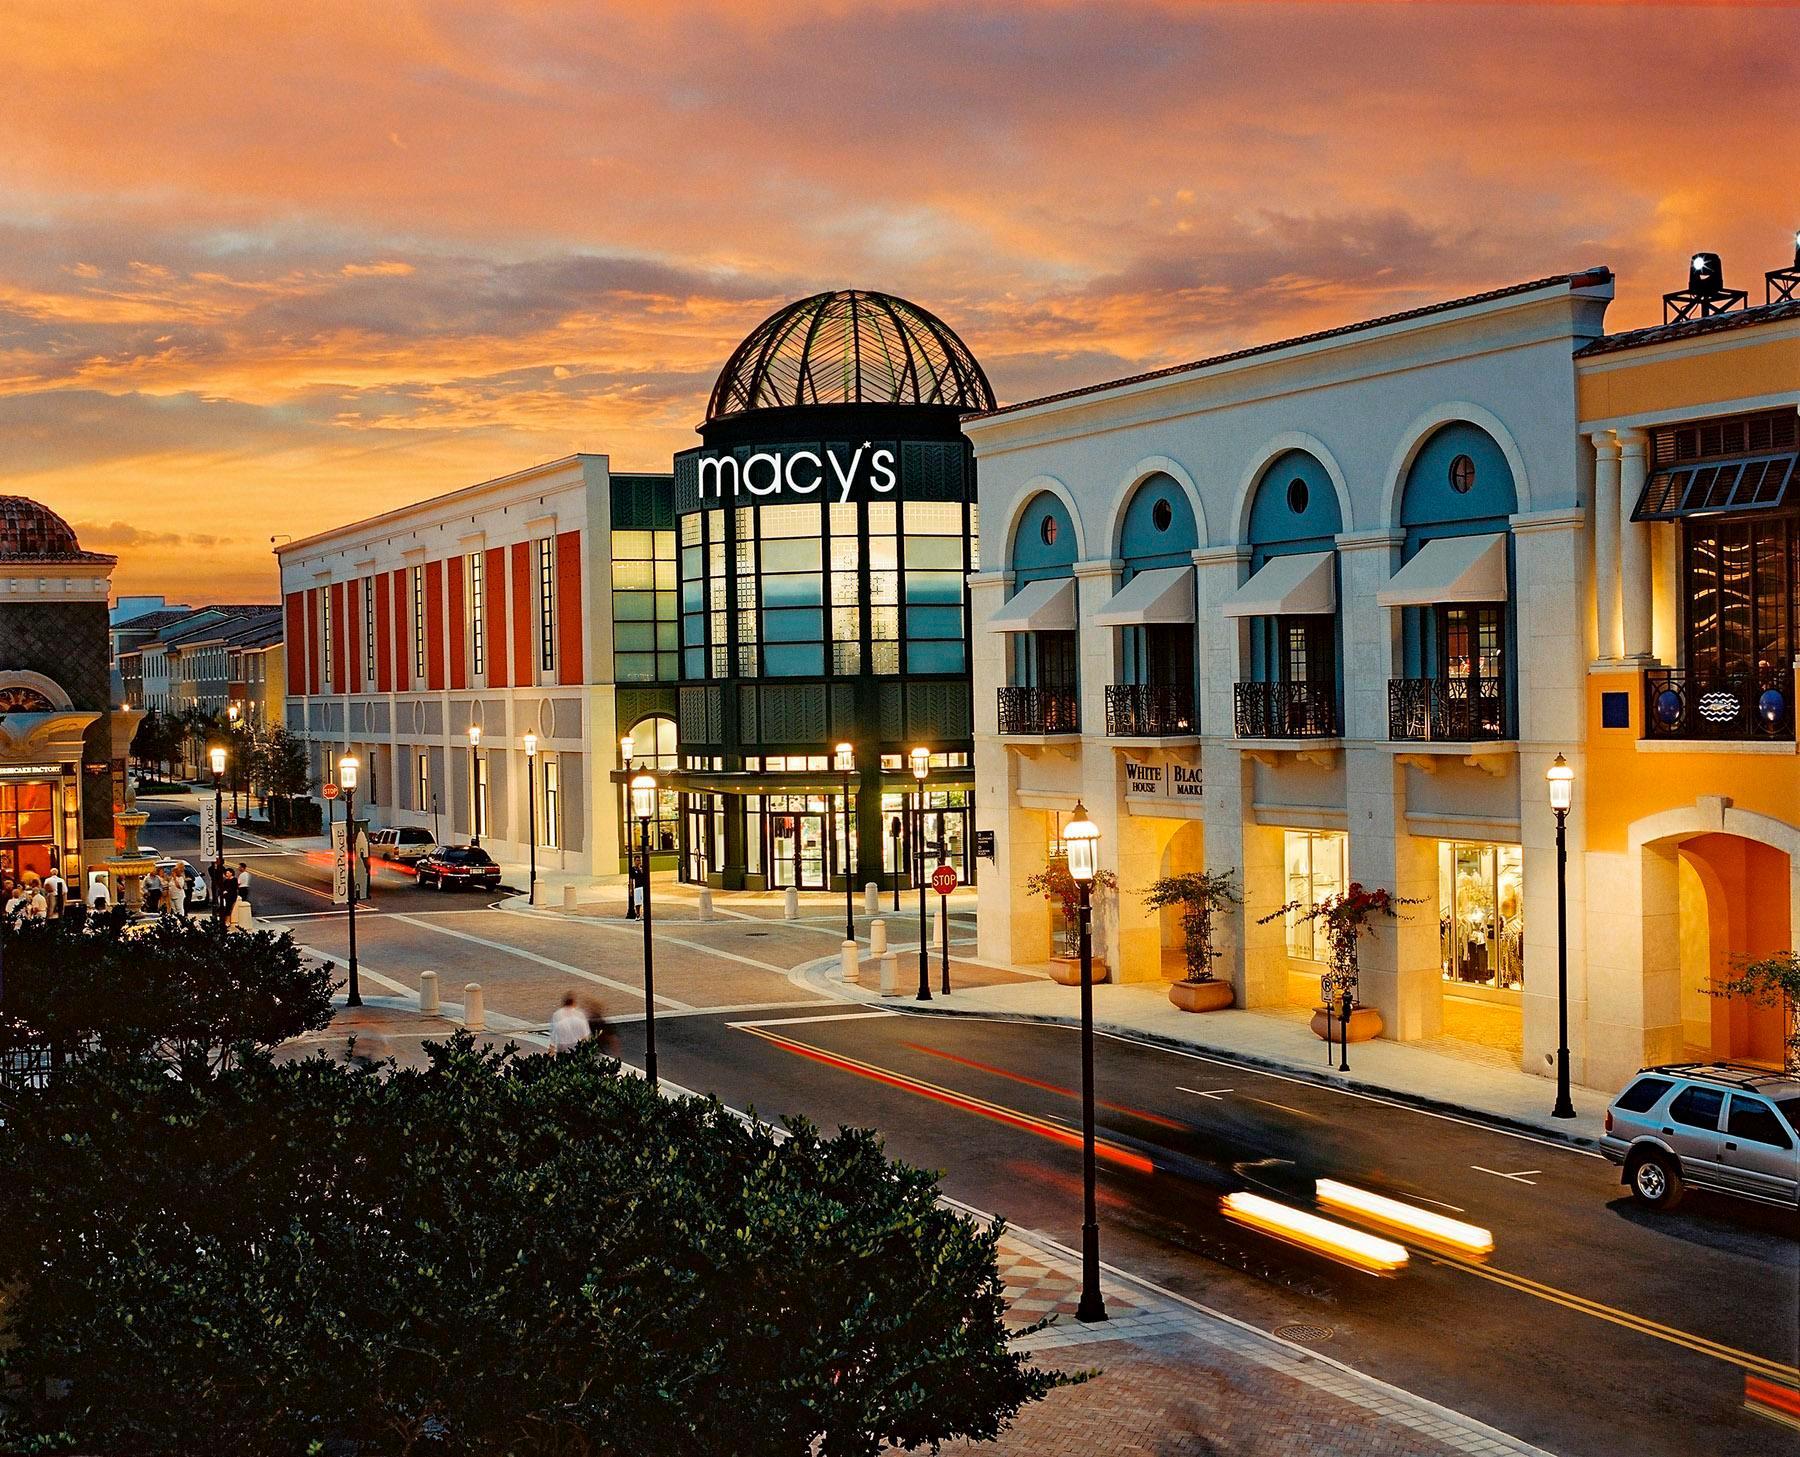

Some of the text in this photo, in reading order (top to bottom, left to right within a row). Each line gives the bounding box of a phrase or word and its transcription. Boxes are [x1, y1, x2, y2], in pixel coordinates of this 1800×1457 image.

[1126, 763, 1161, 780] WHITE
[1173, 765, 1203, 782] BLAC
[1132, 782, 1155, 792] HOUSE
[1177, 785, 1203, 795] MARK
[933, 874, 956, 886] STOP
